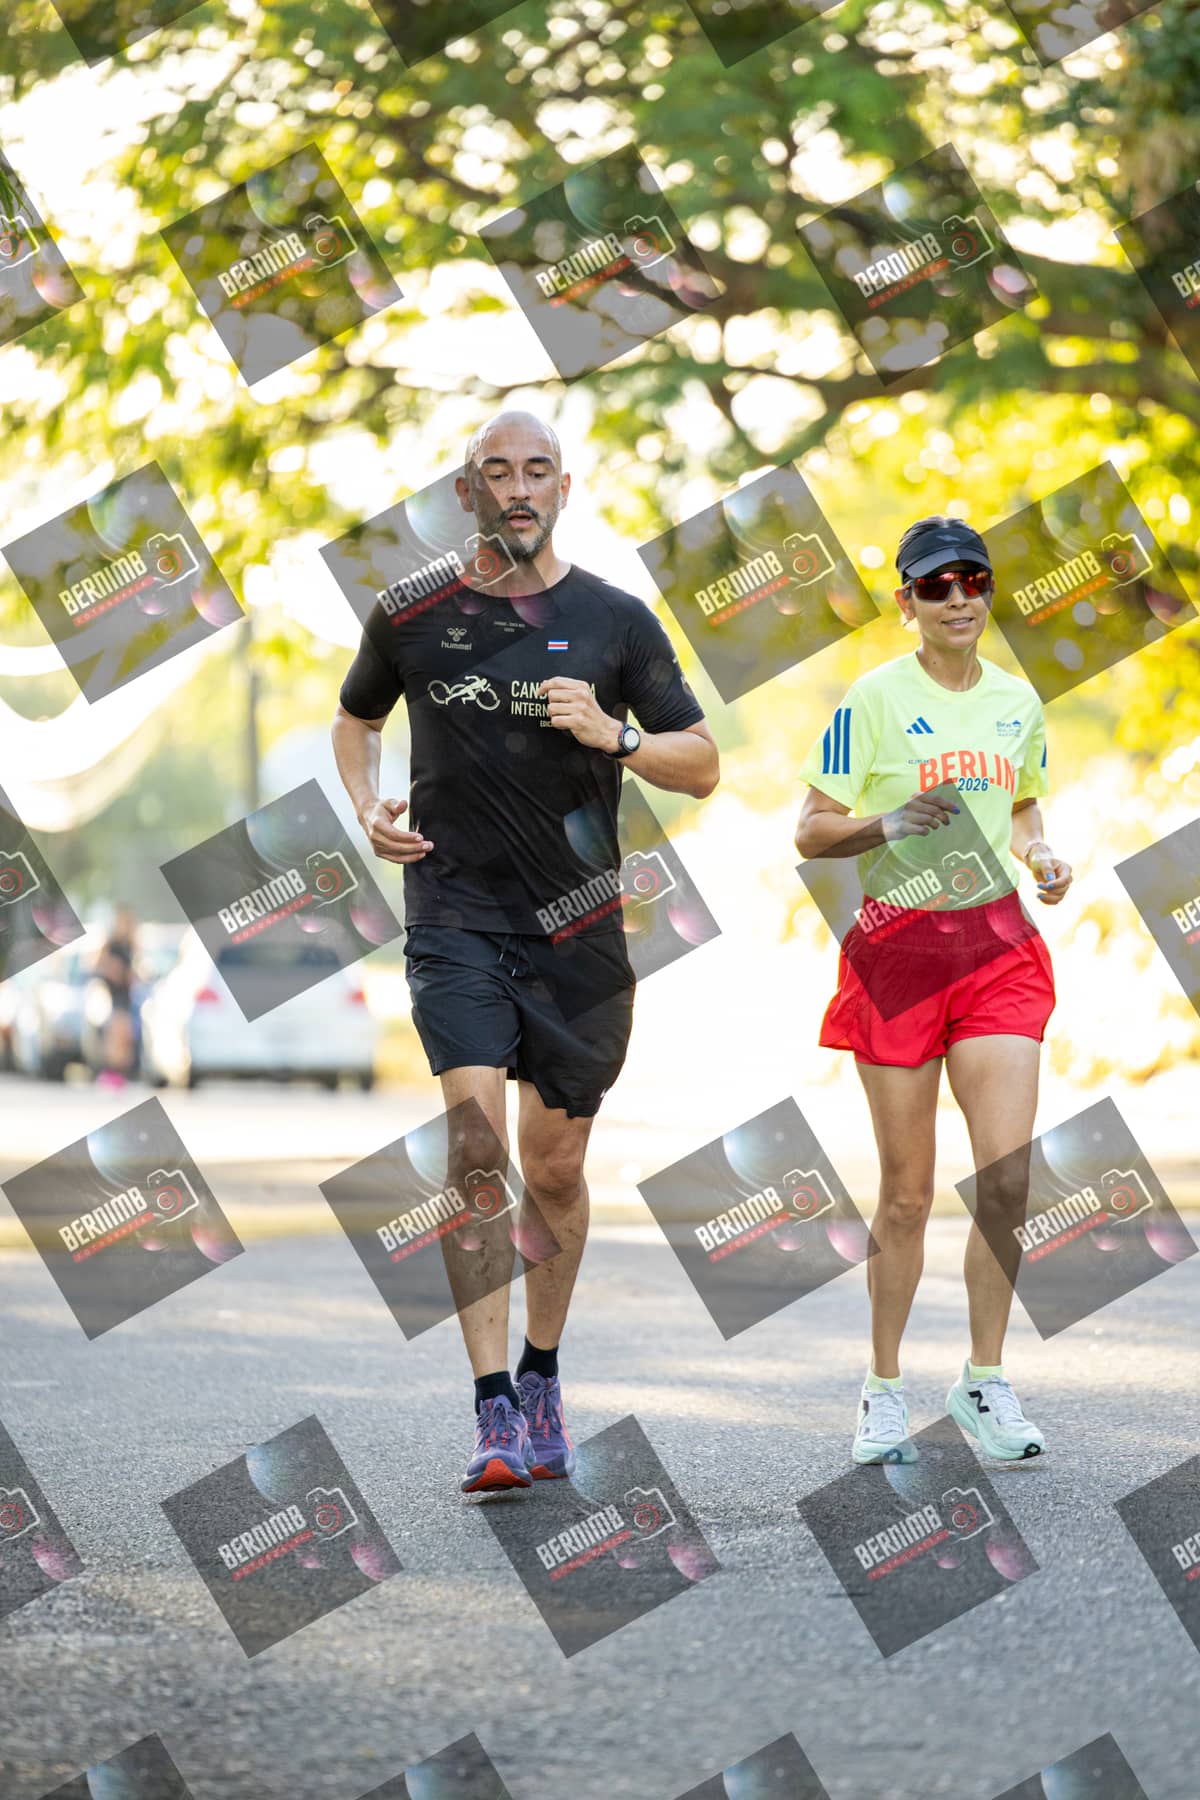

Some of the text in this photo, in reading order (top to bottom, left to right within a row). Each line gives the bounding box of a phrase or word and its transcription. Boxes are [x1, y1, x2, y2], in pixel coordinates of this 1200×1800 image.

[441, 640, 472, 651] hummel
[919, 750, 1016, 797] BERLIN
[958, 777, 989, 791] 2026
